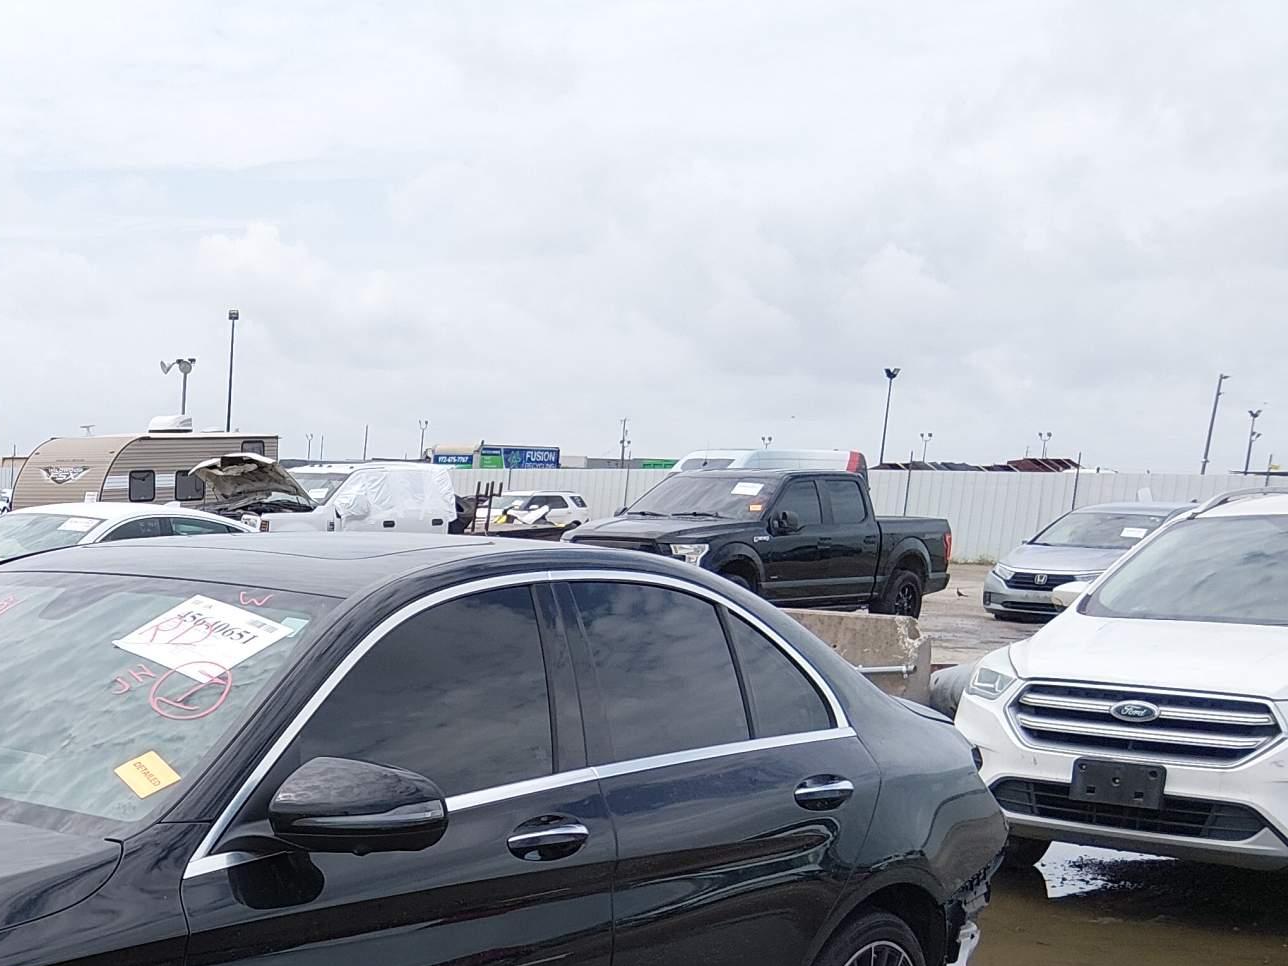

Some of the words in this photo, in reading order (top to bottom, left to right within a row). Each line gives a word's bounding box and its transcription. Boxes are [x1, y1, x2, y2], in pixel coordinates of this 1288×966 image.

[526, 451, 556, 462] FUSION
[177, 610, 259, 645] 45640651
[1121, 704, 1147, 717] Ford
